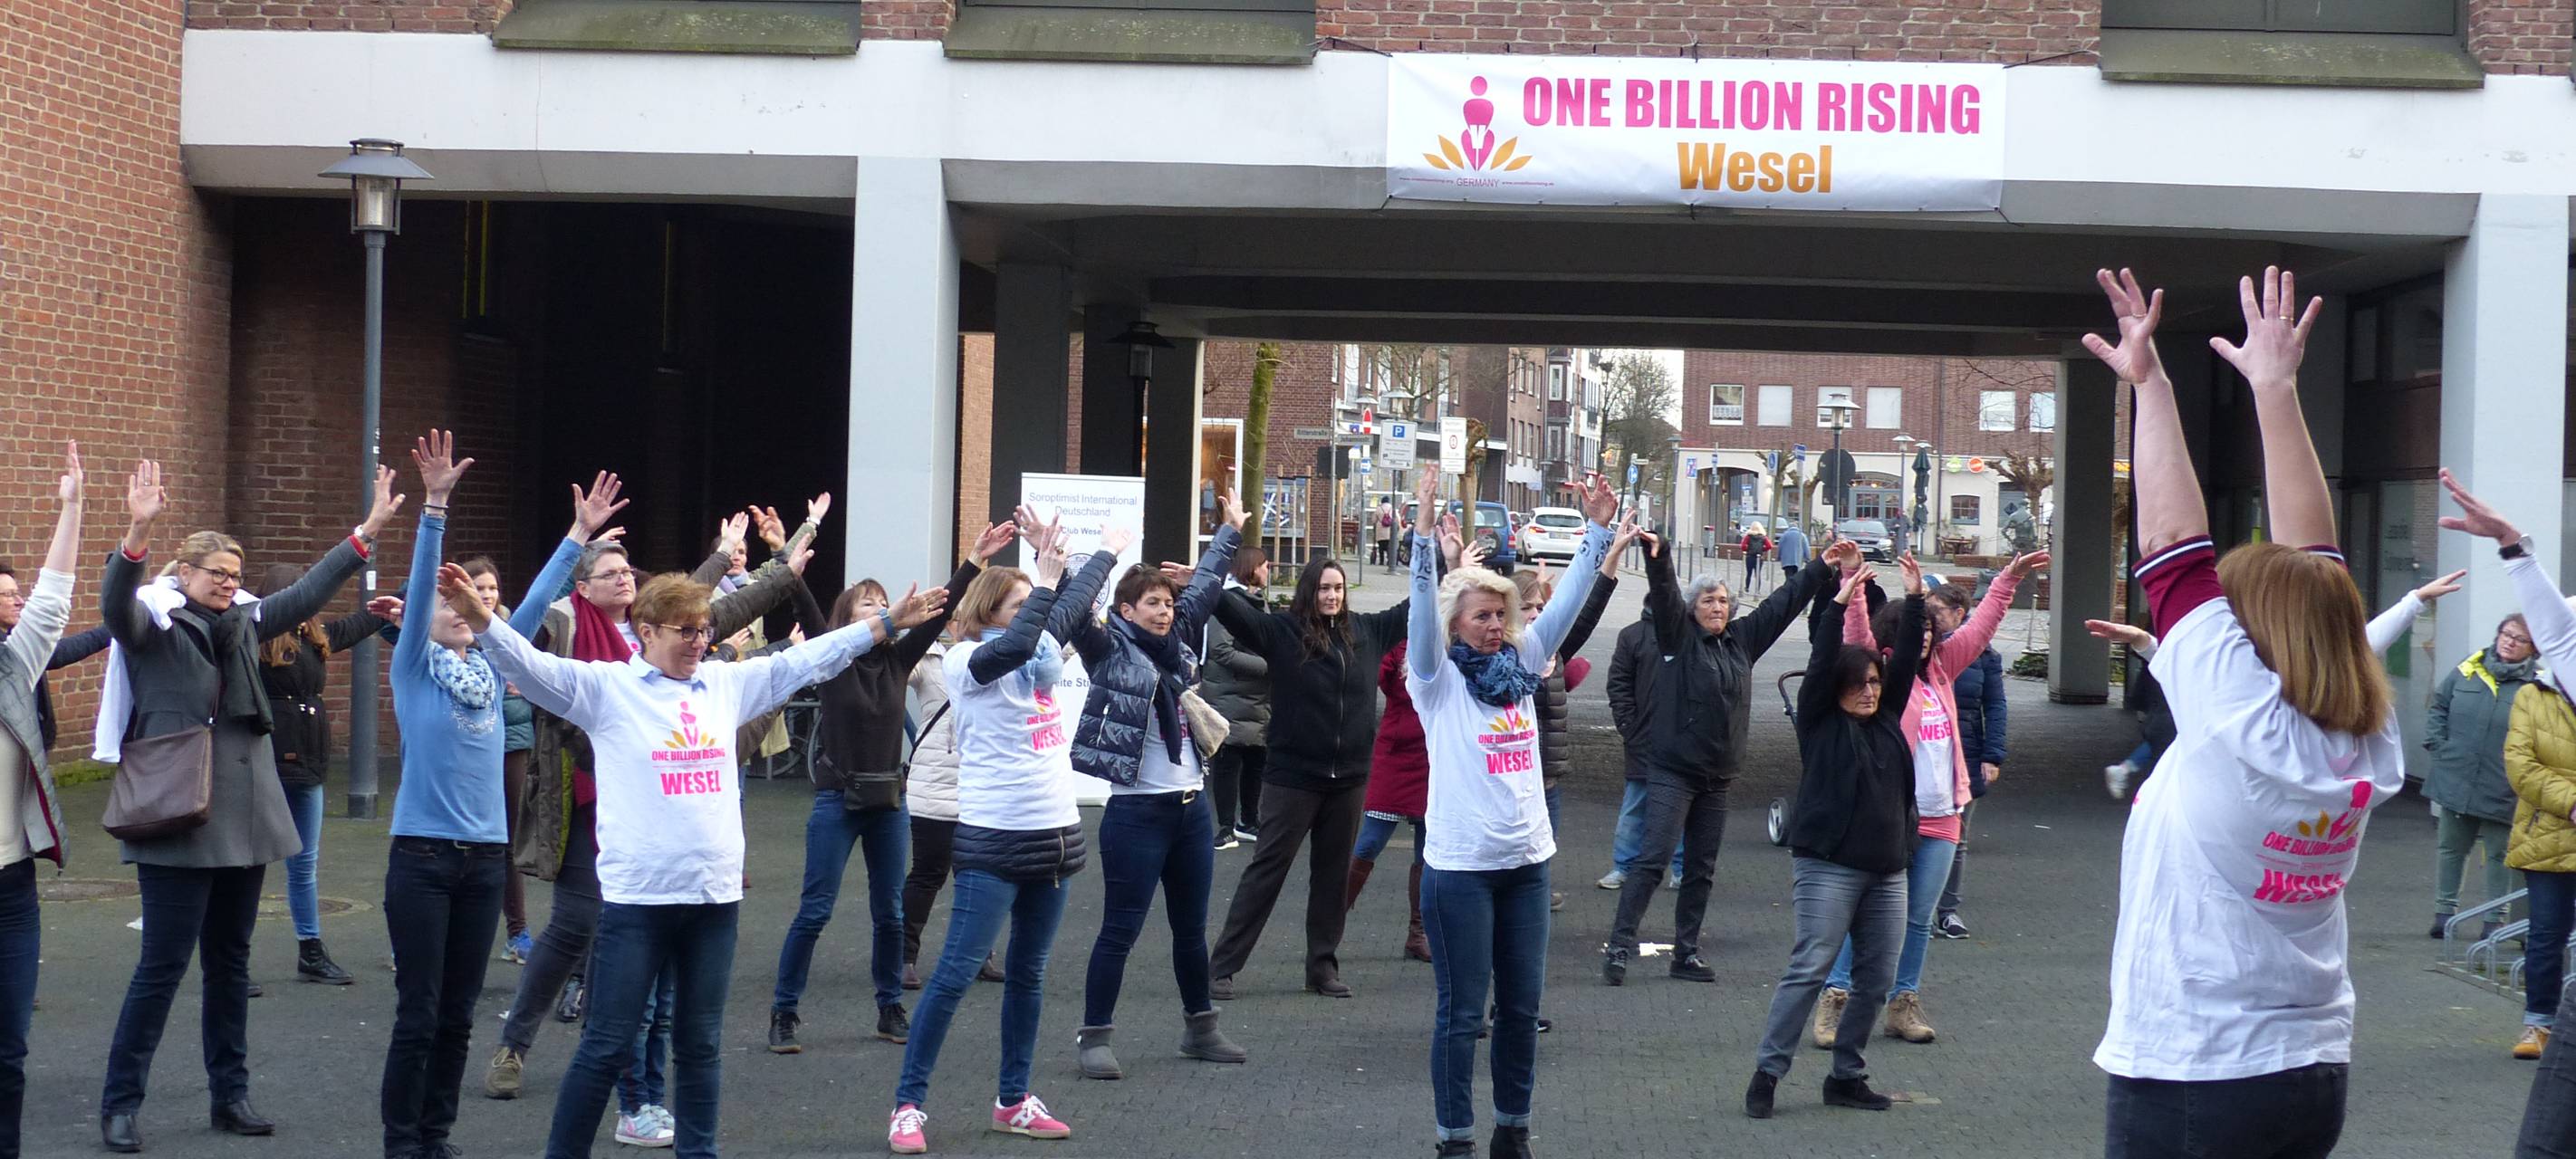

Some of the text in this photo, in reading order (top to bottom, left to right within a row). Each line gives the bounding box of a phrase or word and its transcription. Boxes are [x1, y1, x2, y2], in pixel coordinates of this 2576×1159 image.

[1523, 76, 1980, 134] ONE BILLION RISING
[1677, 142, 1832, 193] Wesel
[1456, 177, 1500, 187] GERMANY
[1029, 492, 1138, 506] Soroptimist International
[1054, 505, 1111, 517] Deutschland
[1081, 528, 1102, 536] Wese
[1478, 734, 1494, 743] ONE
[652, 751, 669, 761] ONE
[1486, 750, 1533, 774] WESEL
[660, 771, 721, 795] WESEL
[2264, 831, 2292, 851] ONE
